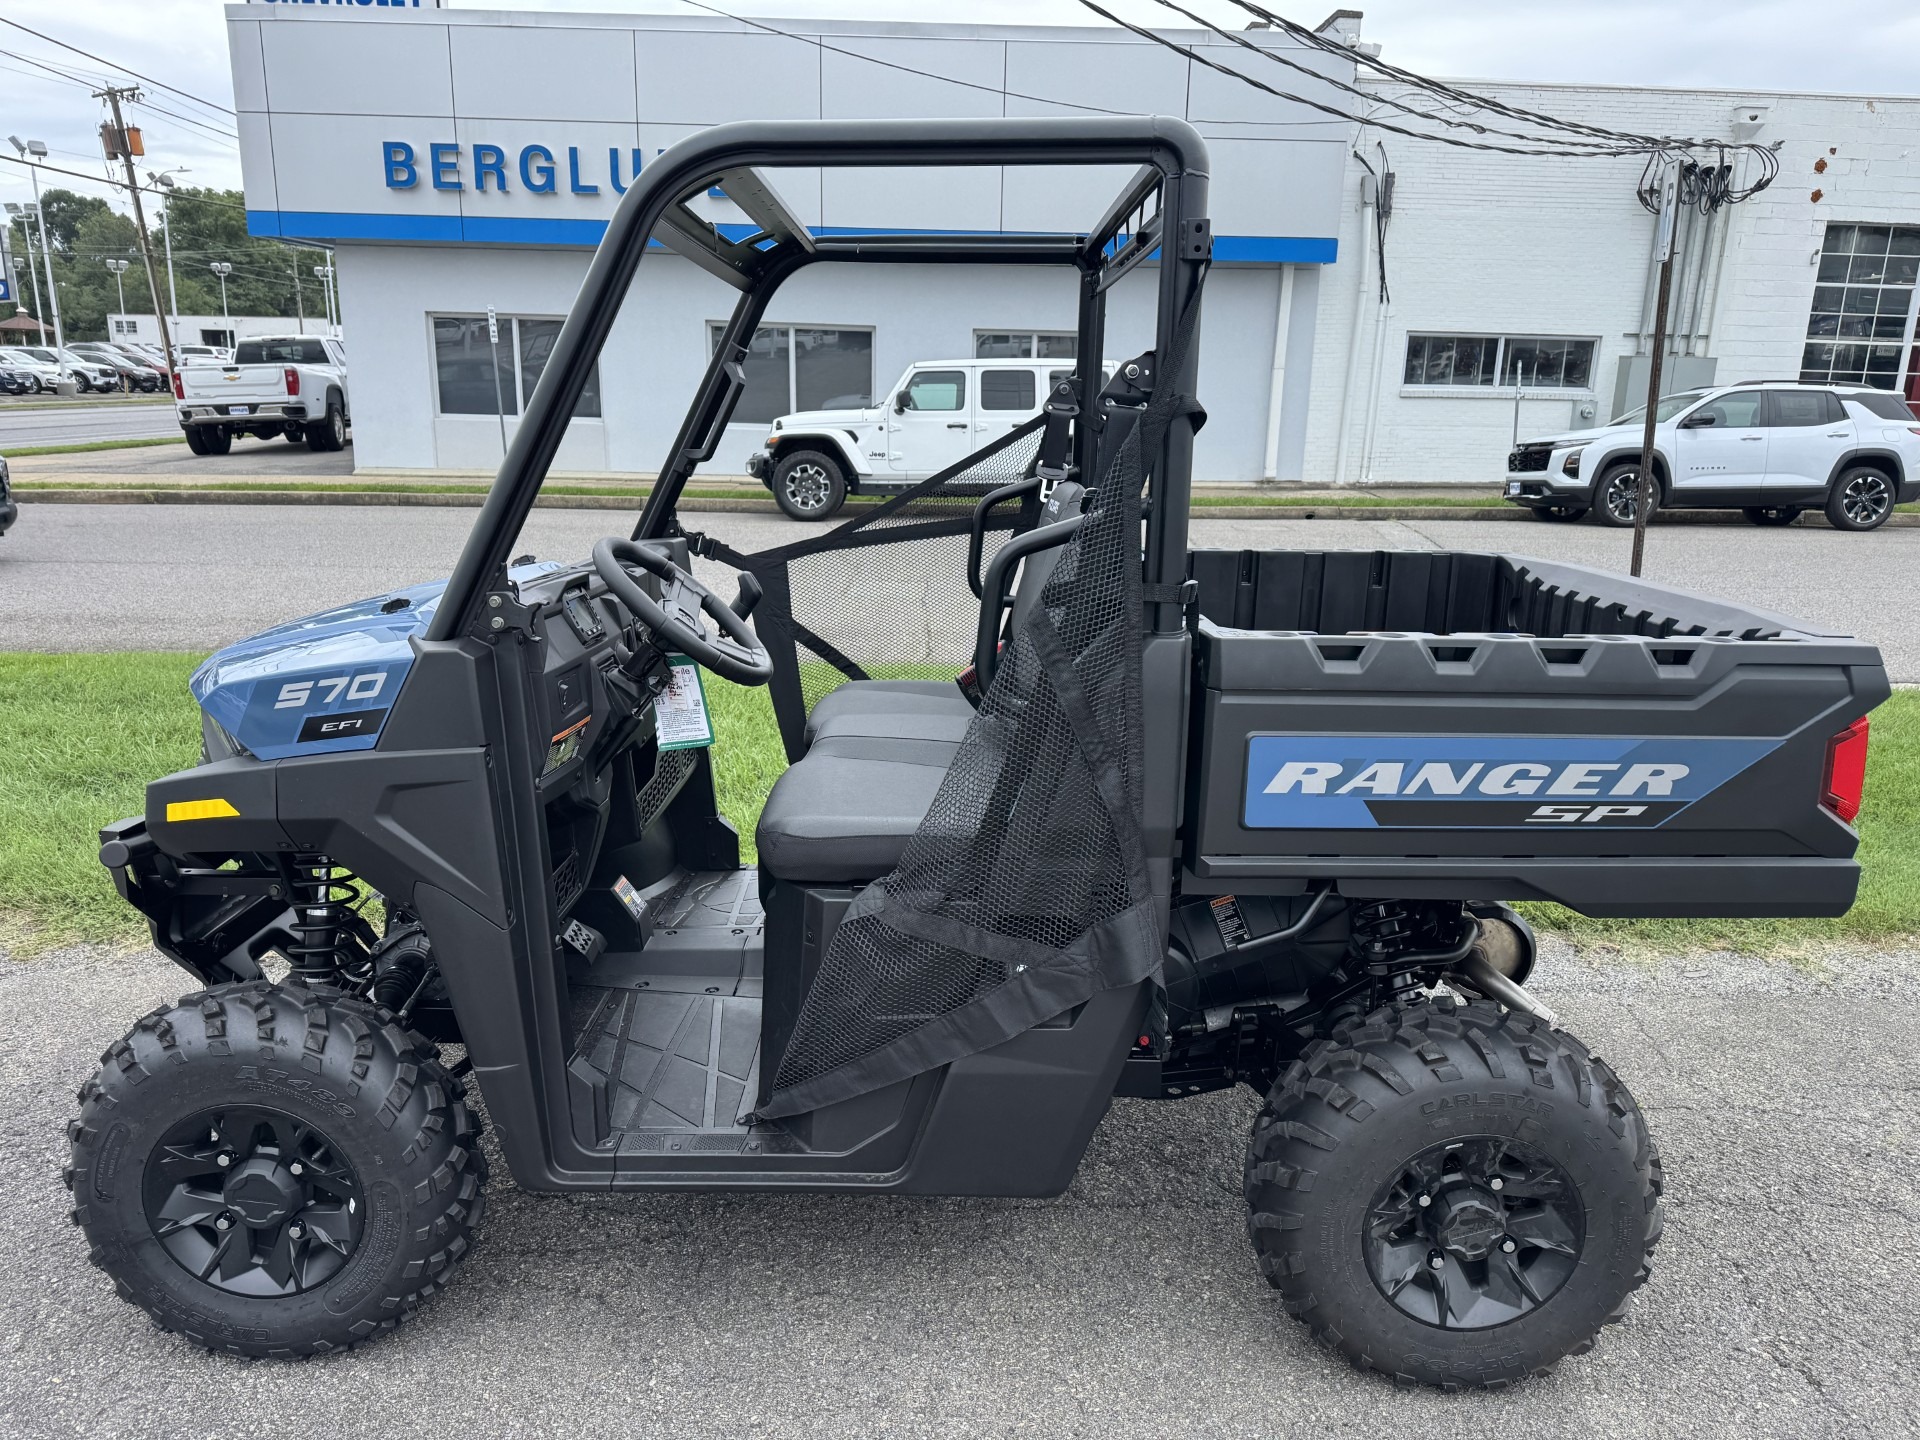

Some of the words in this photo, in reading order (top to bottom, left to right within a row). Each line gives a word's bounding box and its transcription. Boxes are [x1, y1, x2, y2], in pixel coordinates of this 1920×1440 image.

[382, 141, 729, 197] BERGLU
[869, 450, 886, 458] Jeep
[273, 672, 388, 710] 570
[320, 718, 363, 732] EFI
[1262, 761, 1690, 796] RANGER
[1524, 805, 1649, 823] SP
[1418, 1091, 1555, 1120] CARLSTAR
[147, 1283, 272, 1344] CARLSTAR
